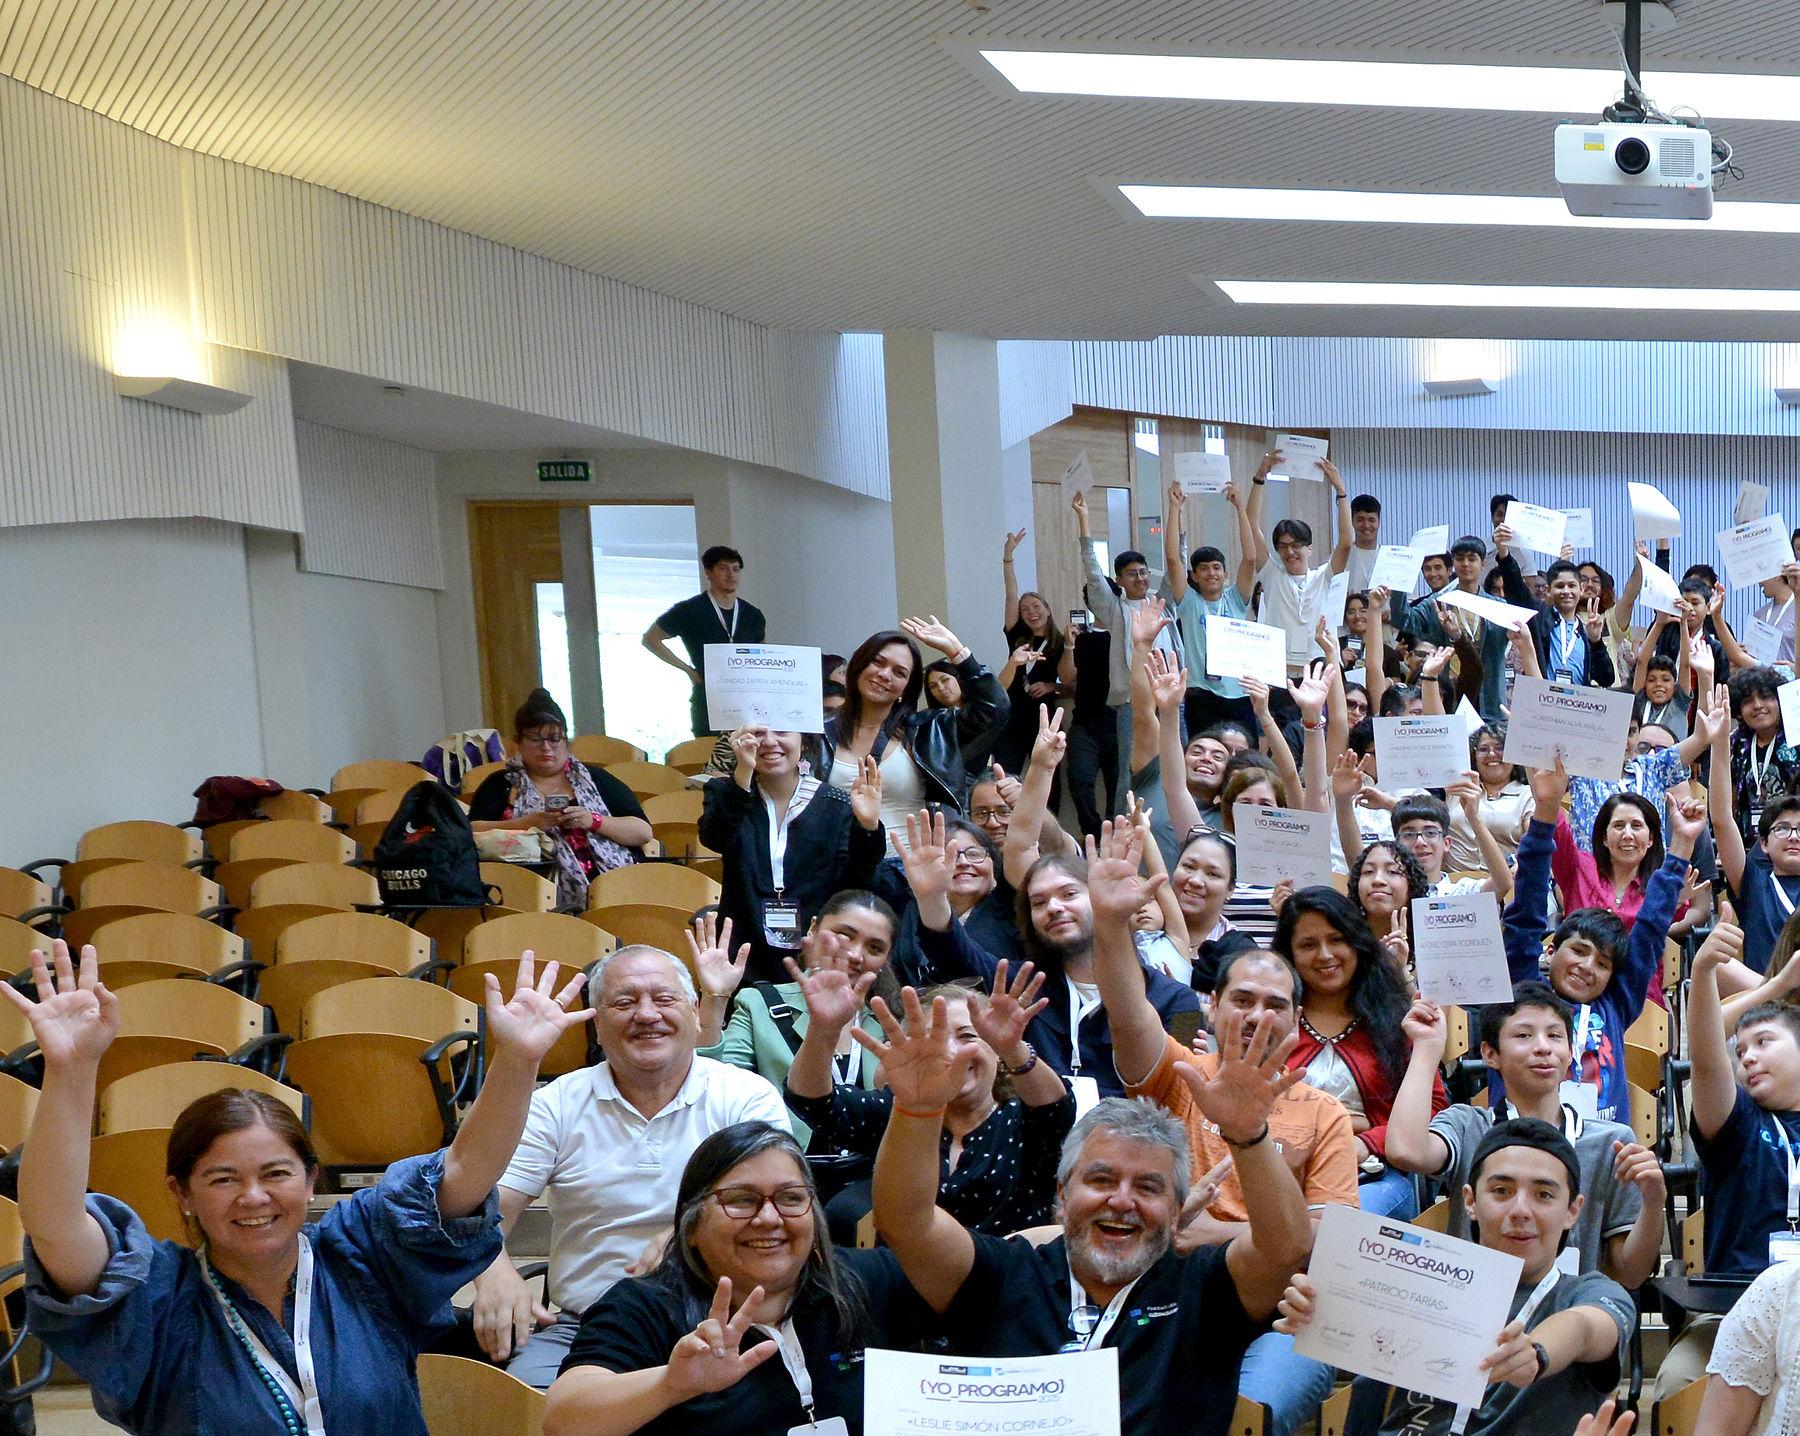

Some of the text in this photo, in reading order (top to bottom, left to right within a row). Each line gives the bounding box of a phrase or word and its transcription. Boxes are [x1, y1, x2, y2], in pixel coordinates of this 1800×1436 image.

[542, 465, 585, 478] SALIDA
[382, 869, 427, 880] CHICAGO
[387, 880, 421, 890] BULLS
[920, 1379, 1065, 1399] {YO_PROGRAMO}
